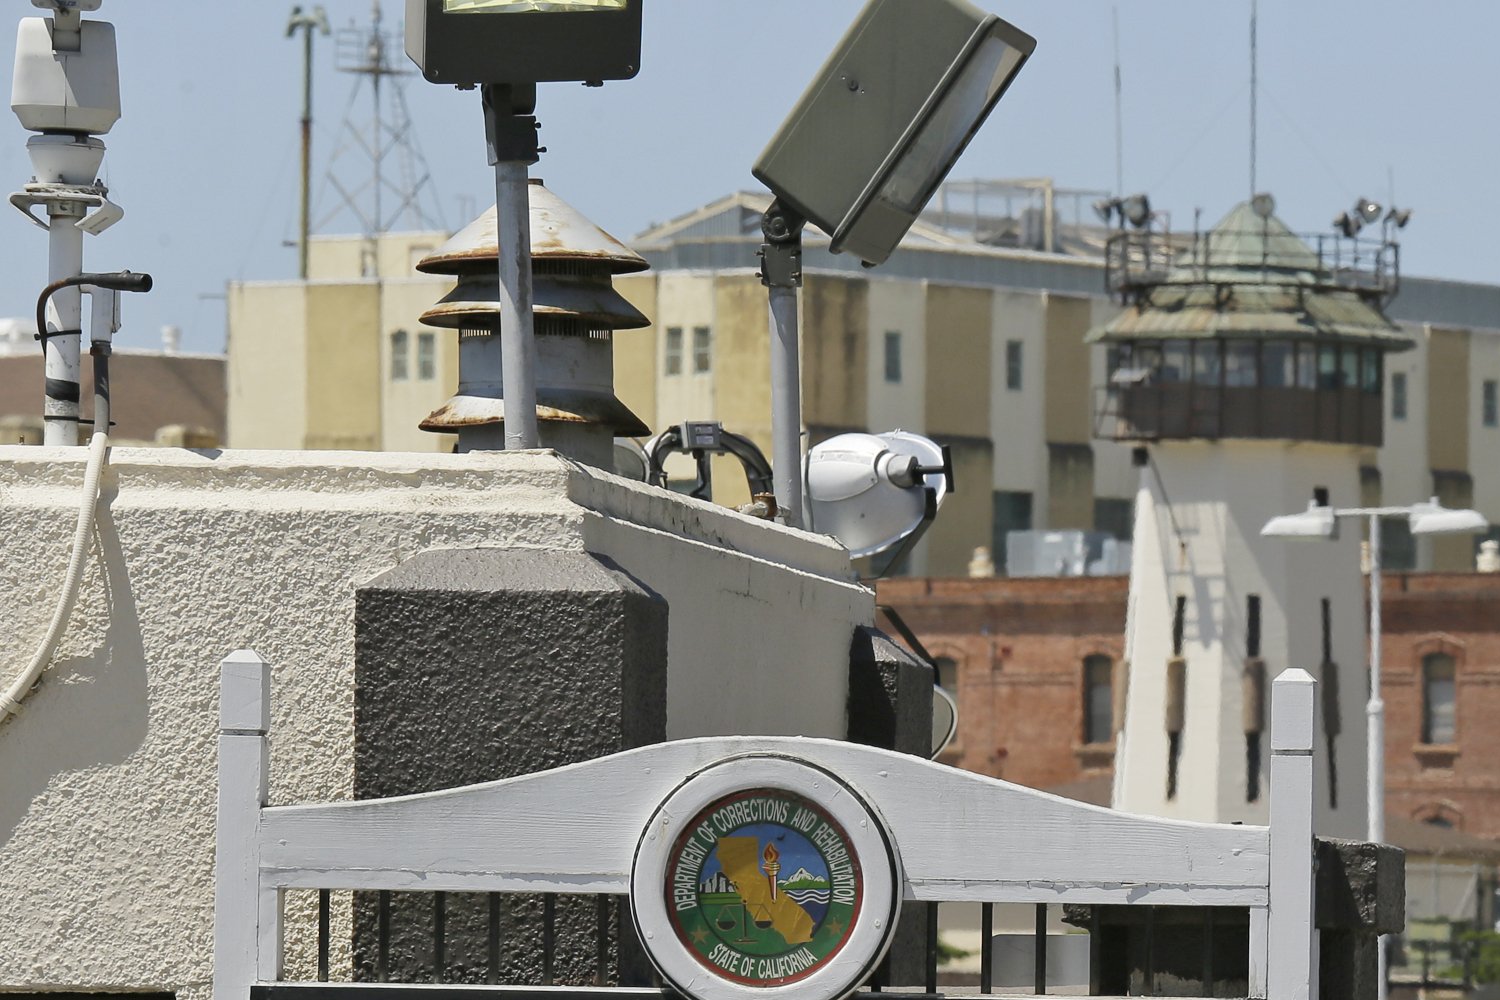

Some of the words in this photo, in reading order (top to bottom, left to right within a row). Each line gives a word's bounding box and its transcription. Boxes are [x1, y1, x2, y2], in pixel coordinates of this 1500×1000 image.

[674, 837, 705, 911] DEPARTMENT
[697, 820, 718, 844] OF
[713, 800, 790, 833] CORRECTIONS
[791, 808, 817, 832] AND
[812, 822, 856, 906] REHABILITATION
[708, 943, 741, 972] STATE
[740, 958, 754, 977] OF
[758, 947, 818, 979] CALIFORNIA
